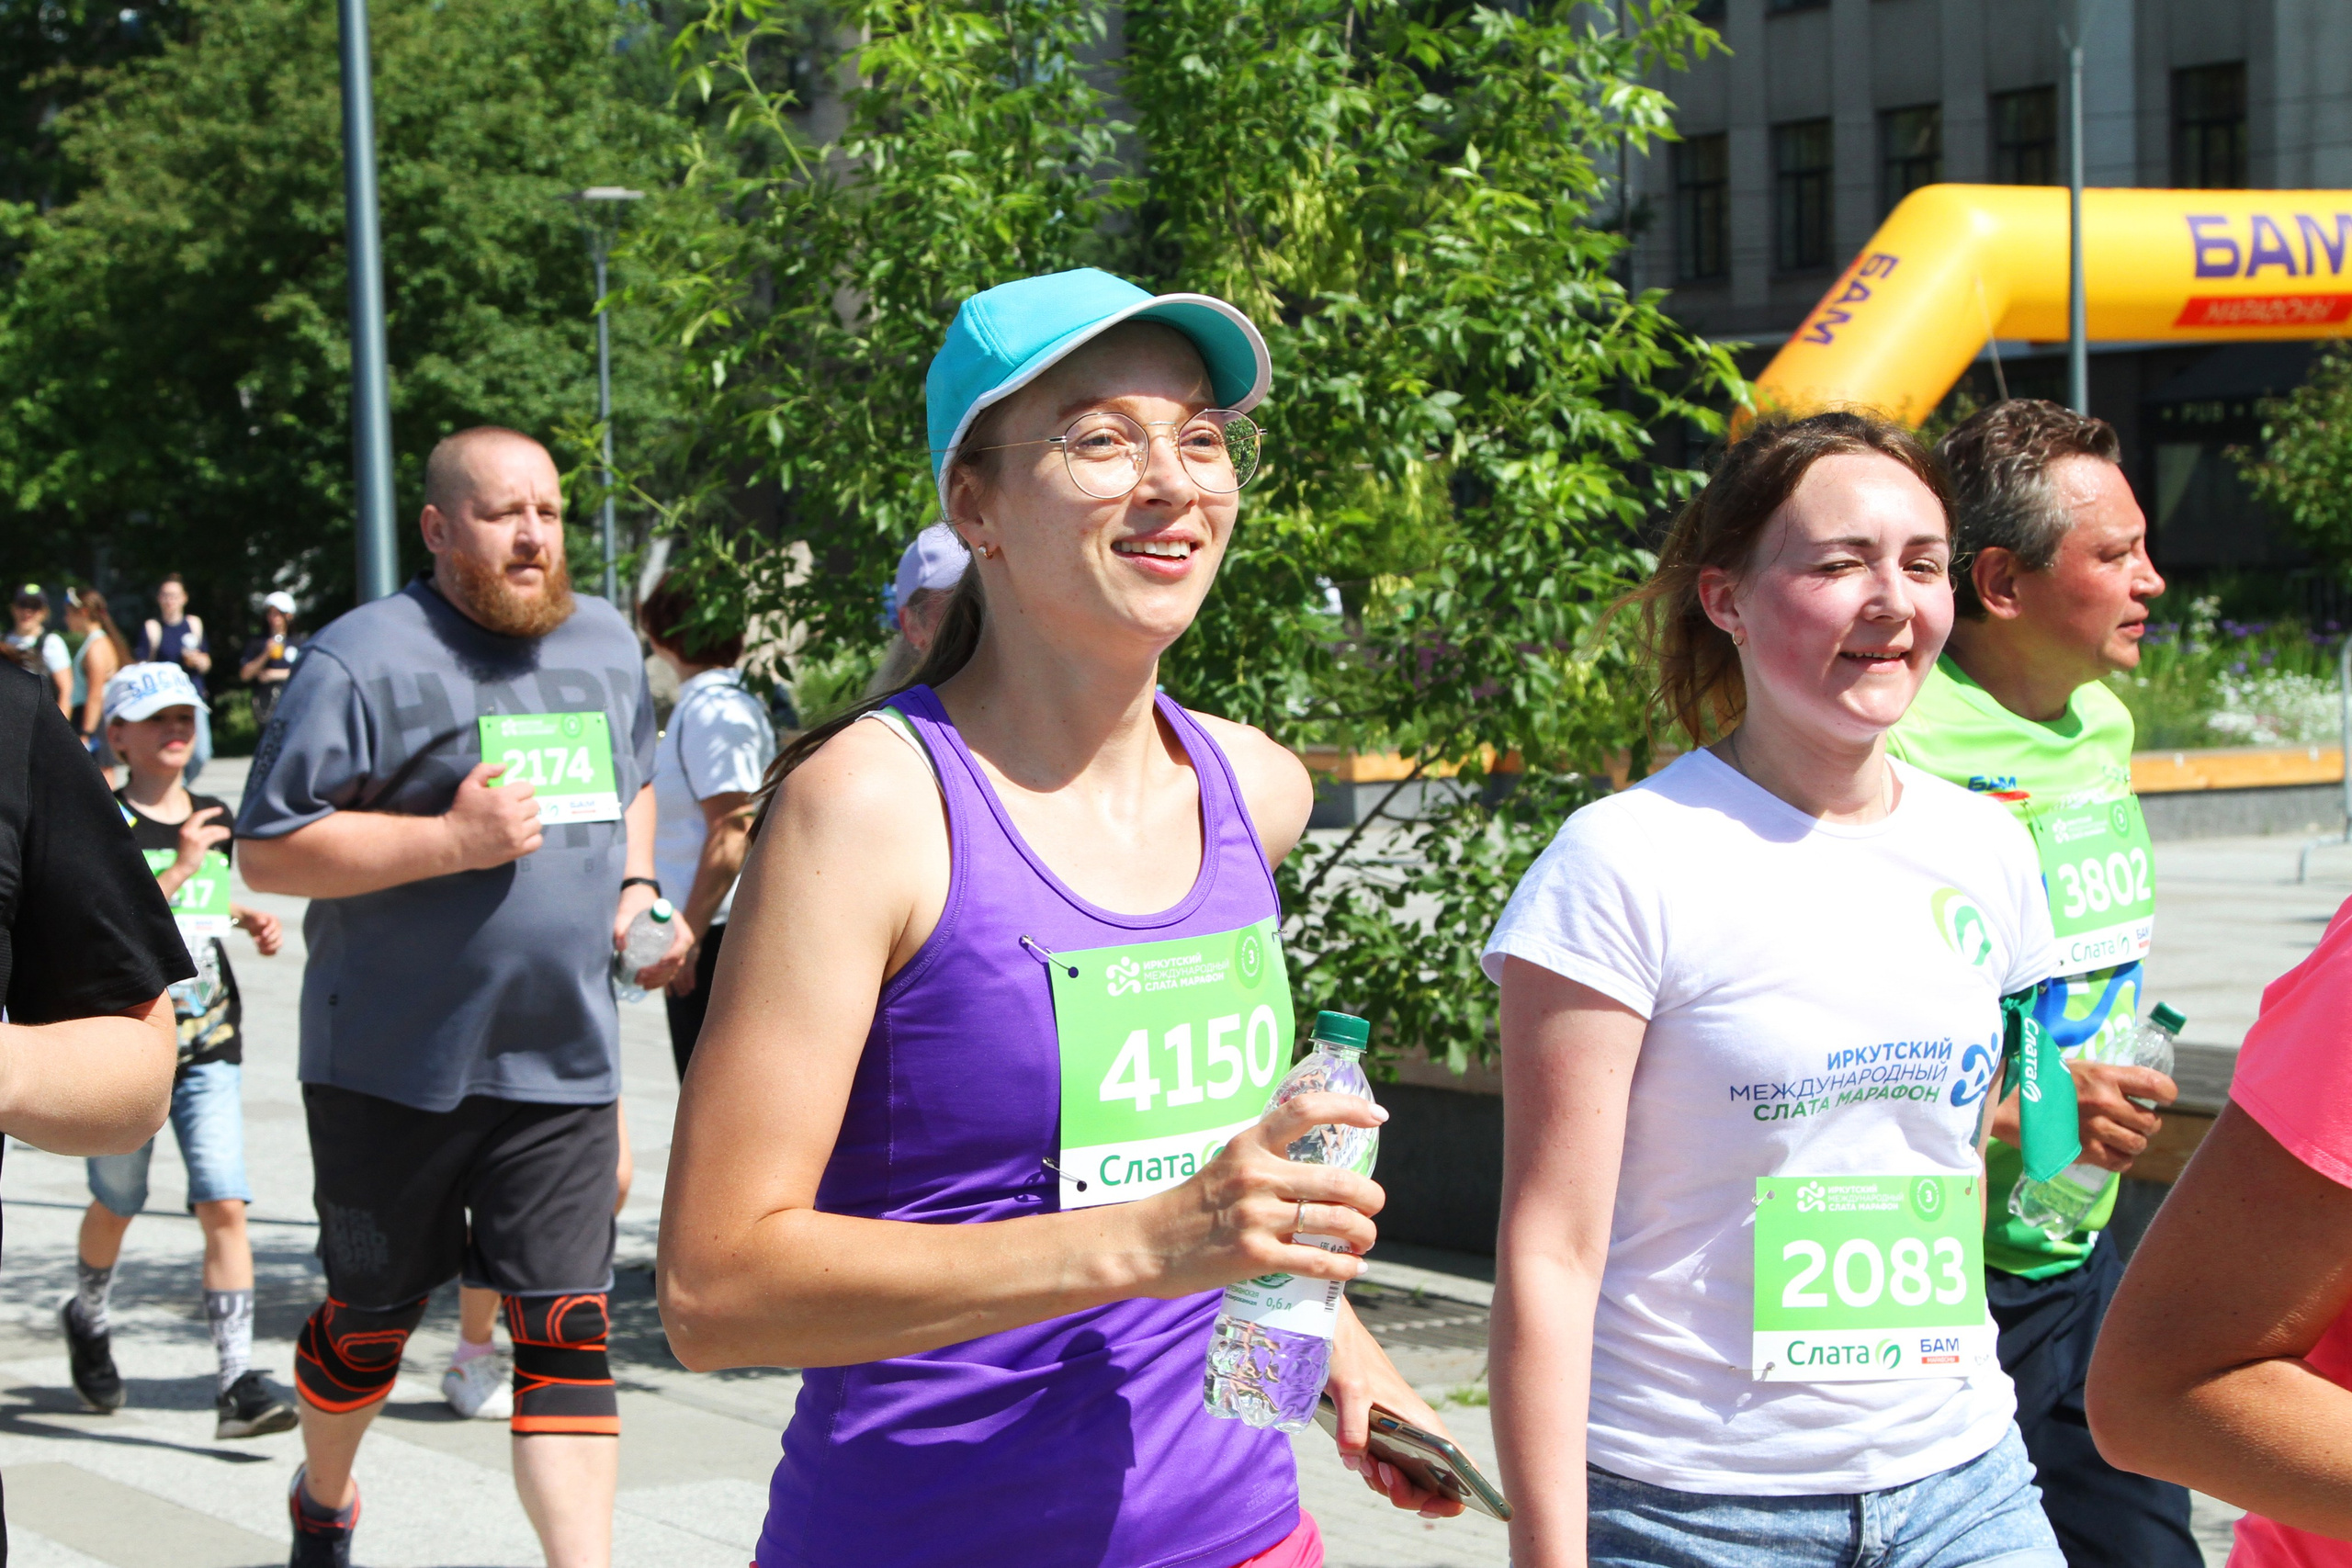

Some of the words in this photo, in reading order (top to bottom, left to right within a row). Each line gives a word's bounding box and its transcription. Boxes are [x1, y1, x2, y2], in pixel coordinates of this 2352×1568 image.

[1804, 254, 1899, 344] БАМ
[503, 746, 594, 786] 2174
[2057, 847, 2152, 919] 3802
[1143, 952, 1202, 970] ИРКУТСКИЙ
[1249, 950, 1255, 964] 3
[2071, 938, 2115, 962] Слата
[1144, 958, 1229, 981] МЕЖДУНАРОДНЫЙ
[1145, 980, 1179, 992] СЛАТА
[1180, 973, 1225, 987] МАРАФОН
[1099, 1004, 1279, 1111] 4150
[1827, 1037, 1953, 1071] ИРКУТСКИЙ
[2023, 1017, 2040, 1081] Слата
[1730, 1060, 1949, 1102] МЕЖДУНАРОДНЫЙ
[1754, 1096, 1830, 1122] СЛАТА
[1835, 1084, 1941, 1109] МАРАФОН
[1100, 1152, 1195, 1187] Слата
[1828, 1183, 1878, 1194] ИРКУТСКИЙ
[1926, 1190, 1933, 1203] 3
[1828, 1203, 1857, 1212] СЛАТА
[1859, 1202, 1899, 1211] МАРАФОН
[1781, 1236, 1968, 1308] 2083
[1266, 1296, 1283, 1311] 0,6
[1787, 1340, 1871, 1366] Слата
[1920, 1337, 1959, 1352] БАМ
